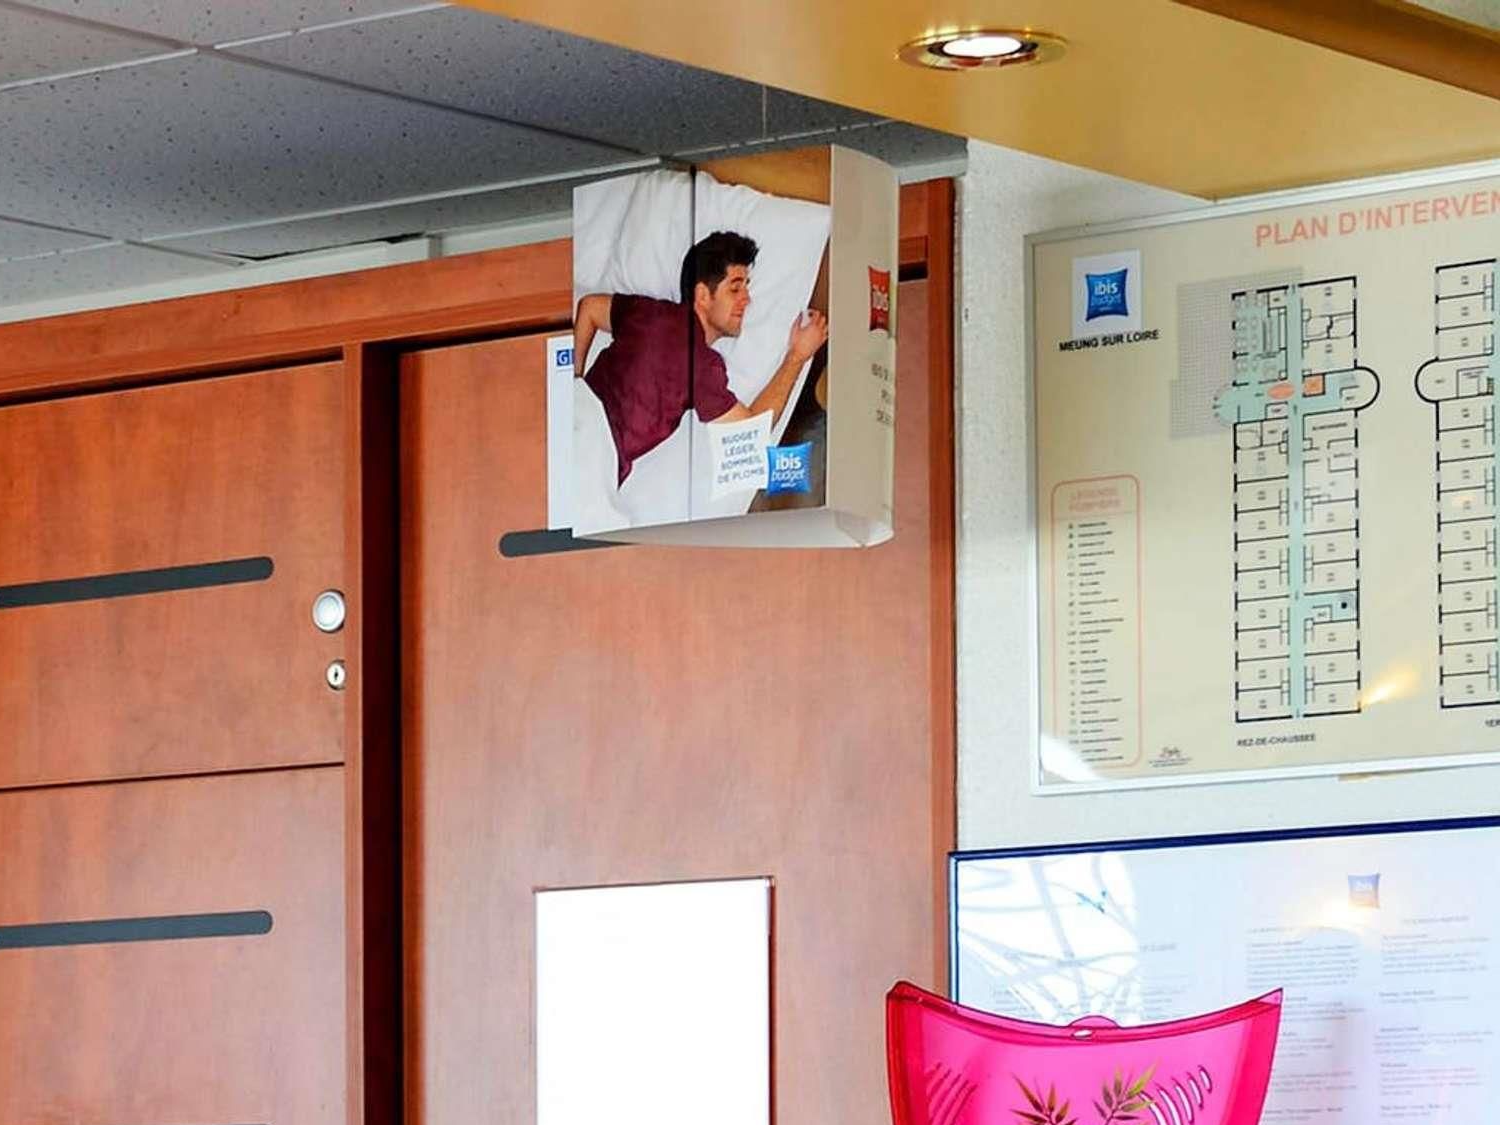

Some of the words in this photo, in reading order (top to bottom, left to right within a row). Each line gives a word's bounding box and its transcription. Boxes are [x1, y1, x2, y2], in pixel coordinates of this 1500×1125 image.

[1256, 215, 1329, 247] PLAN
[1101, 334, 1124, 347] SUR
[775, 453, 802, 470] ibis
[771, 468, 804, 482] budget
